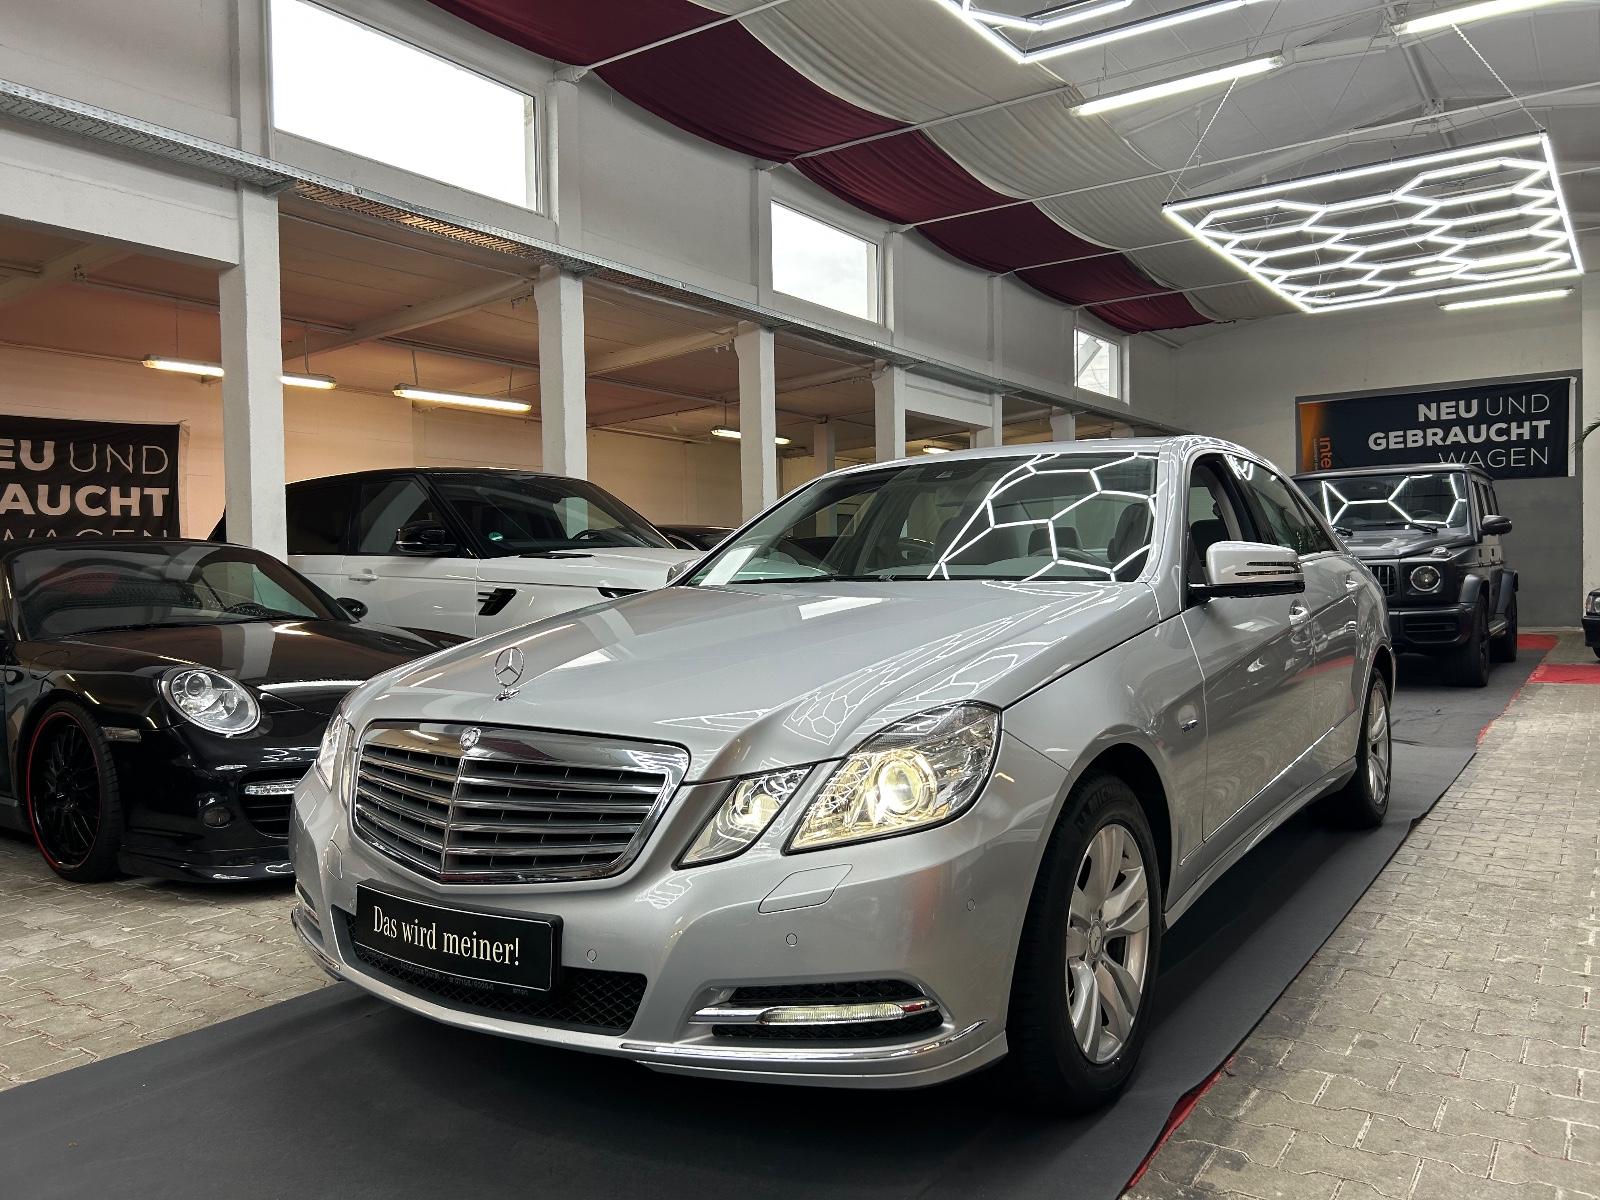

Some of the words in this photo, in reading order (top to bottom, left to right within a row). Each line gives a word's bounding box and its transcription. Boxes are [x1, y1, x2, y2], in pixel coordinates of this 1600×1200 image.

[1418, 399, 1478, 422] NEU
[1486, 394, 1550, 416] UND
[1368, 420, 1551, 450] GEBRAUCHT
[0, 438, 55, 471] EU
[69, 442, 168, 474] UND
[1439, 446, 1549, 468] WAGEN
[0, 483, 170, 517] AUCHT
[373, 905, 397, 938] Das
[401, 918, 437, 950] wird
[442, 931, 520, 966] meiner!
